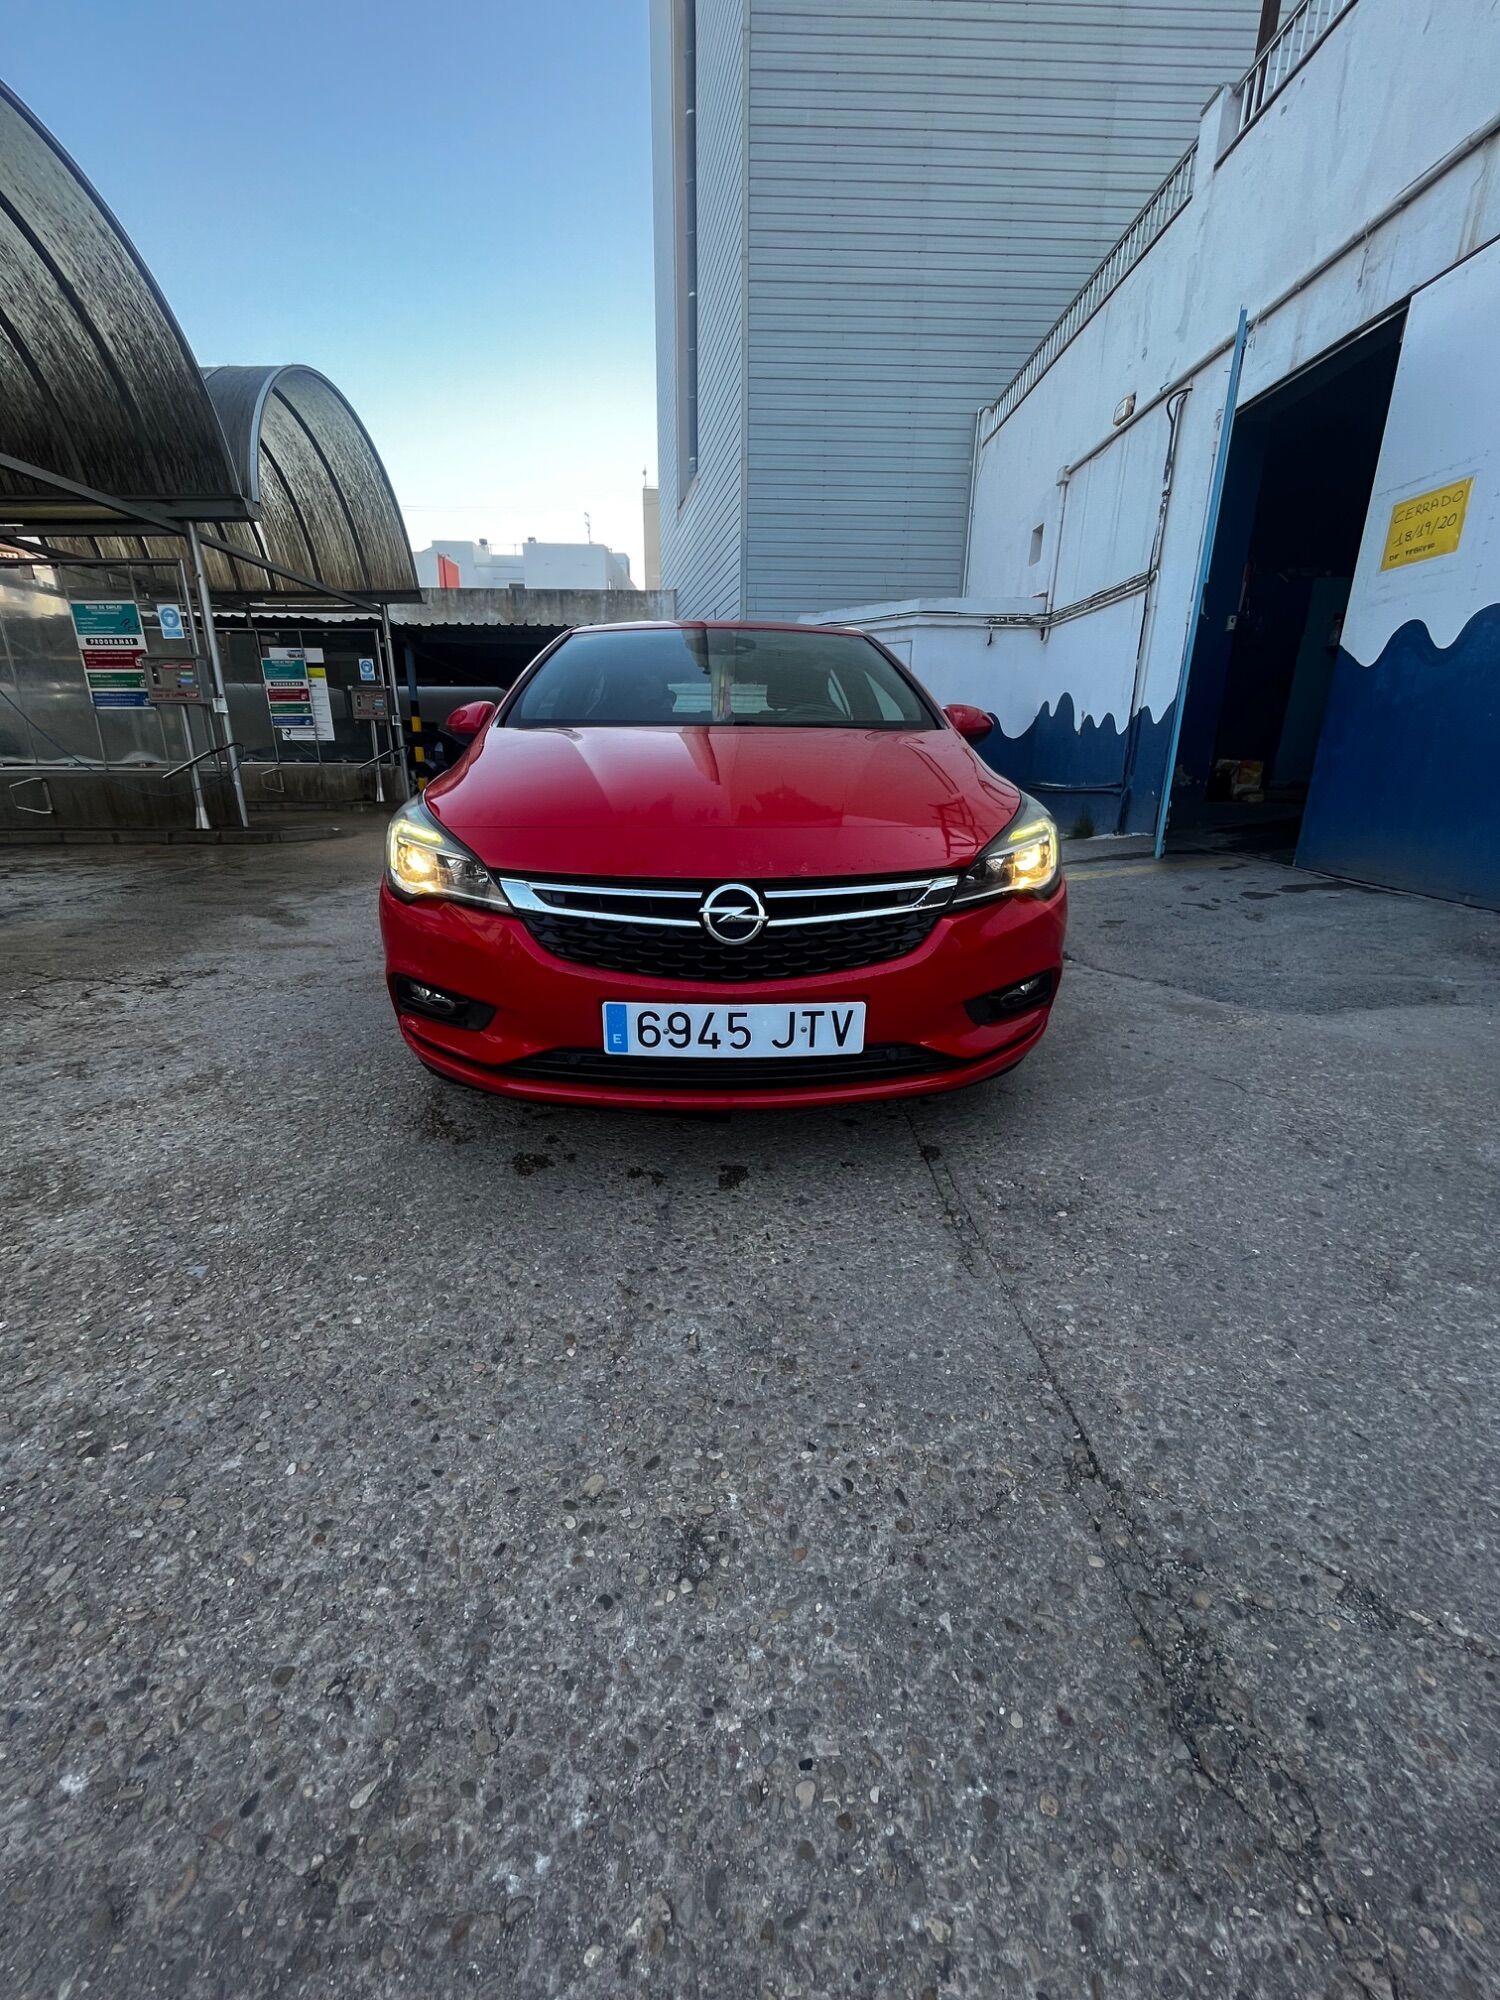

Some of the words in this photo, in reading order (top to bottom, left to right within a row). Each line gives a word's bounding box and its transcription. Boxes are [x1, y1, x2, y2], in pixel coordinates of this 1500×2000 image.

[1394, 490, 1464, 524] CERRADO
[1392, 512, 1457, 548] 18/19/20
[613, 1034, 622, 1044] E
[637, 1010, 752, 1049] 6945
[771, 1010, 854, 1048] JTV
